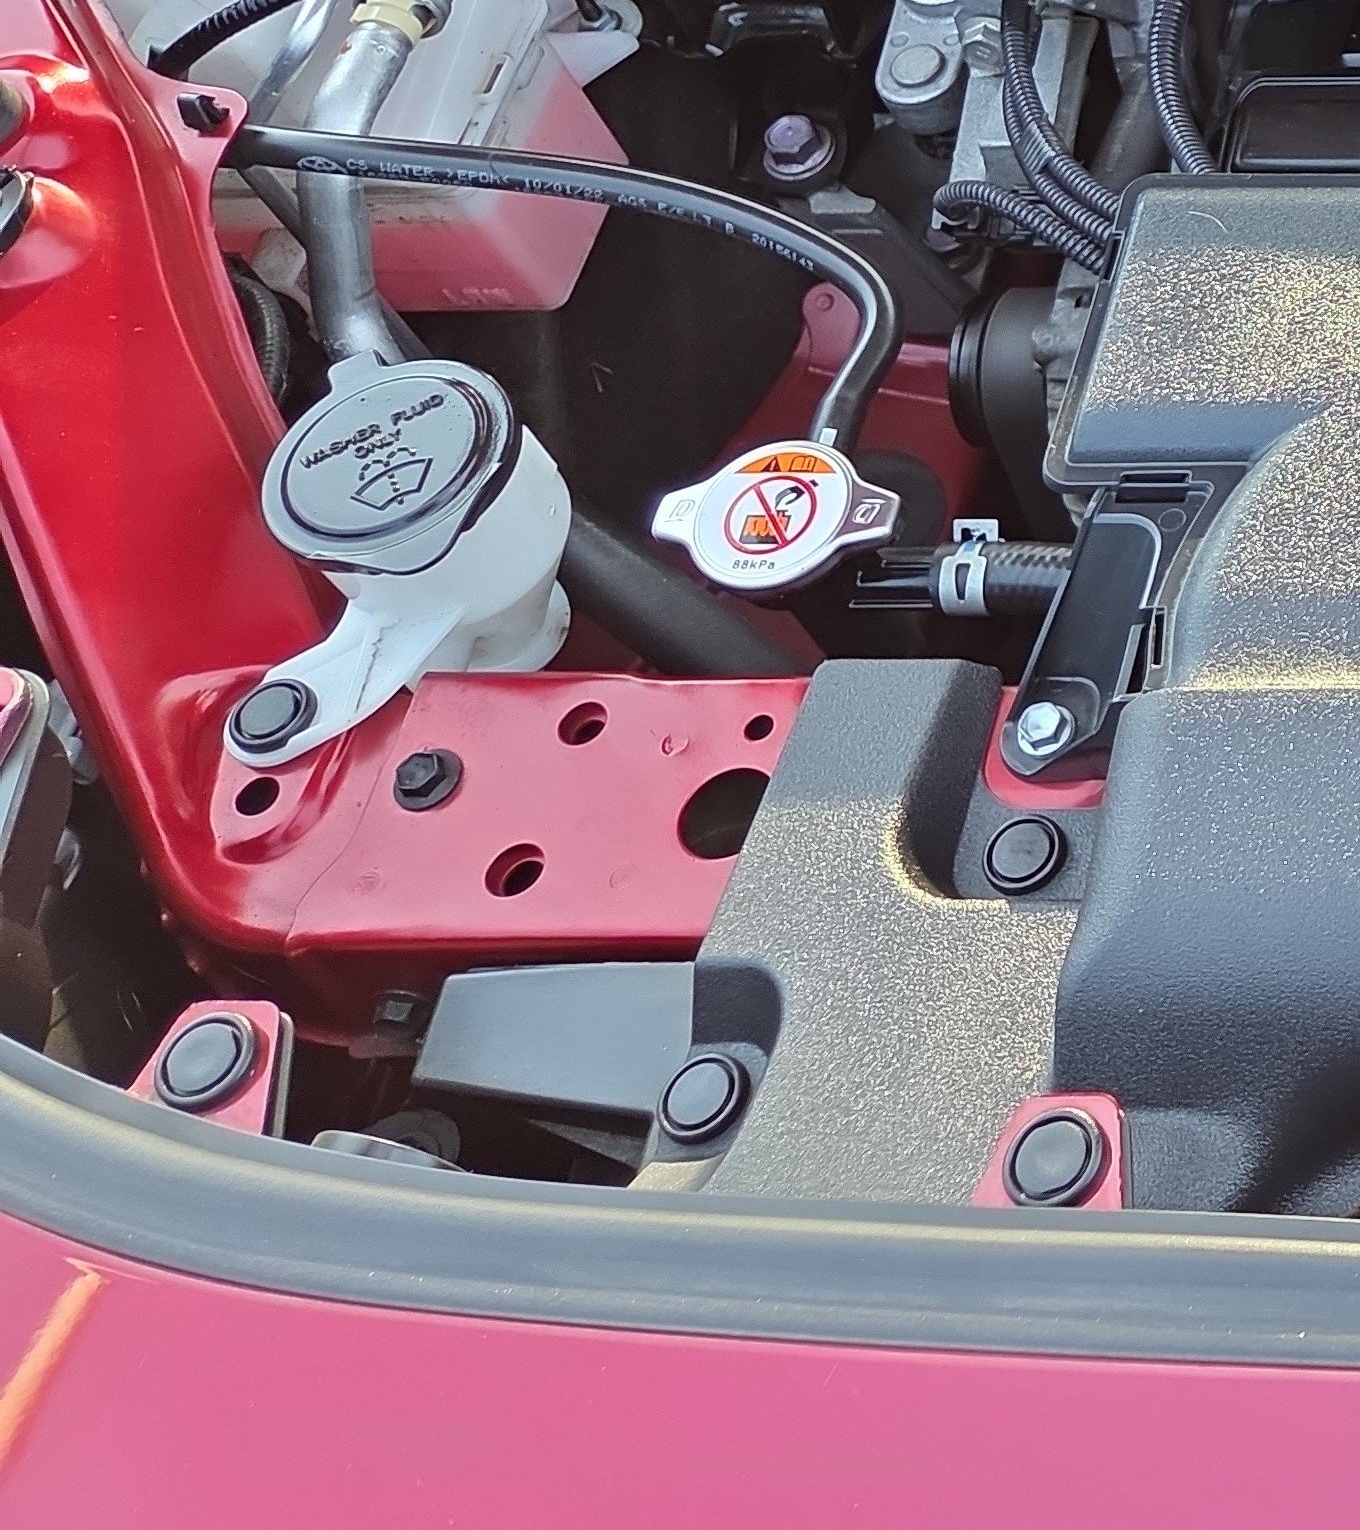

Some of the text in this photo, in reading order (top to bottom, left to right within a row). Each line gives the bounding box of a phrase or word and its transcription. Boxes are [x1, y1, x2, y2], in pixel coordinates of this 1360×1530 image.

[346, 158, 368, 170] CS
[380, 162, 434, 177] WATER
[300, 393, 445, 469] WASHER FLUID
[353, 428, 402, 459] ONLY
[732, 560, 775, 570] 88kPa
